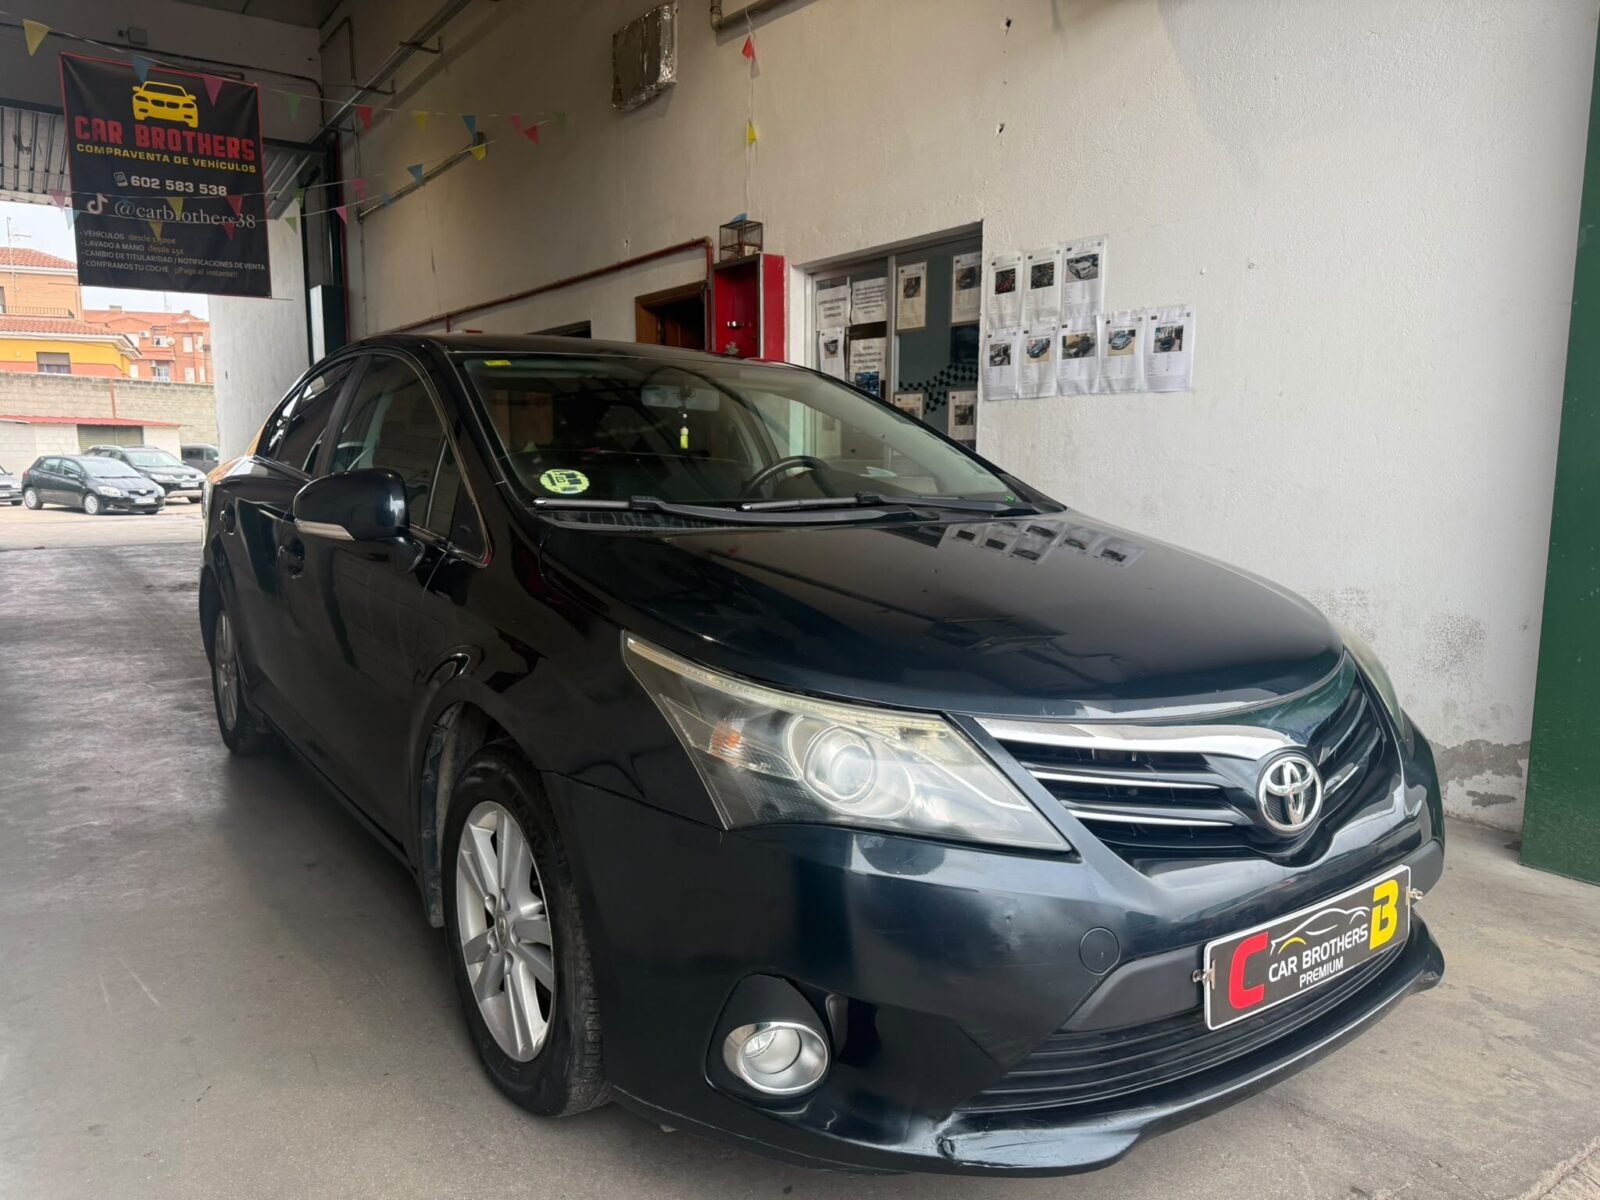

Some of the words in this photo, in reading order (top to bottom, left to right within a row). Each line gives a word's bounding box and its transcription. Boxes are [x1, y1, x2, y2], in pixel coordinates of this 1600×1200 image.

[75, 116, 123, 144] CAR
[135, 124, 255, 161] BROTHERS
[76, 143, 170, 163] COMPRAVENTA
[174, 155, 189, 165] DE
[192, 158, 257, 173] VEHÍCULOS
[130, 176, 161, 189] 602
[165, 179, 195, 193] 583
[199, 183, 228, 197] 538
[84, 240, 114, 249] LAVADO
[122, 243, 145, 251] MANO
[85, 250, 114, 259] CAMBIO
[115, 252, 125, 260] DE
[126, 253, 173, 263] TITULARIDAD
[177, 257, 233, 268] NOTIFICACIONES
[244, 263, 266, 271] VENTA
[86, 260, 133, 270] COMPRAMOS
[134, 263, 144, 271] TU
[145, 264, 169, 273] COCHE
[1369, 879, 1399, 950] B
[1268, 956, 1298, 983] CAR
[1302, 923, 1368, 970] BROTHERS
[1229, 931, 1269, 1009] C
[1299, 957, 1344, 988] PREMIUM
